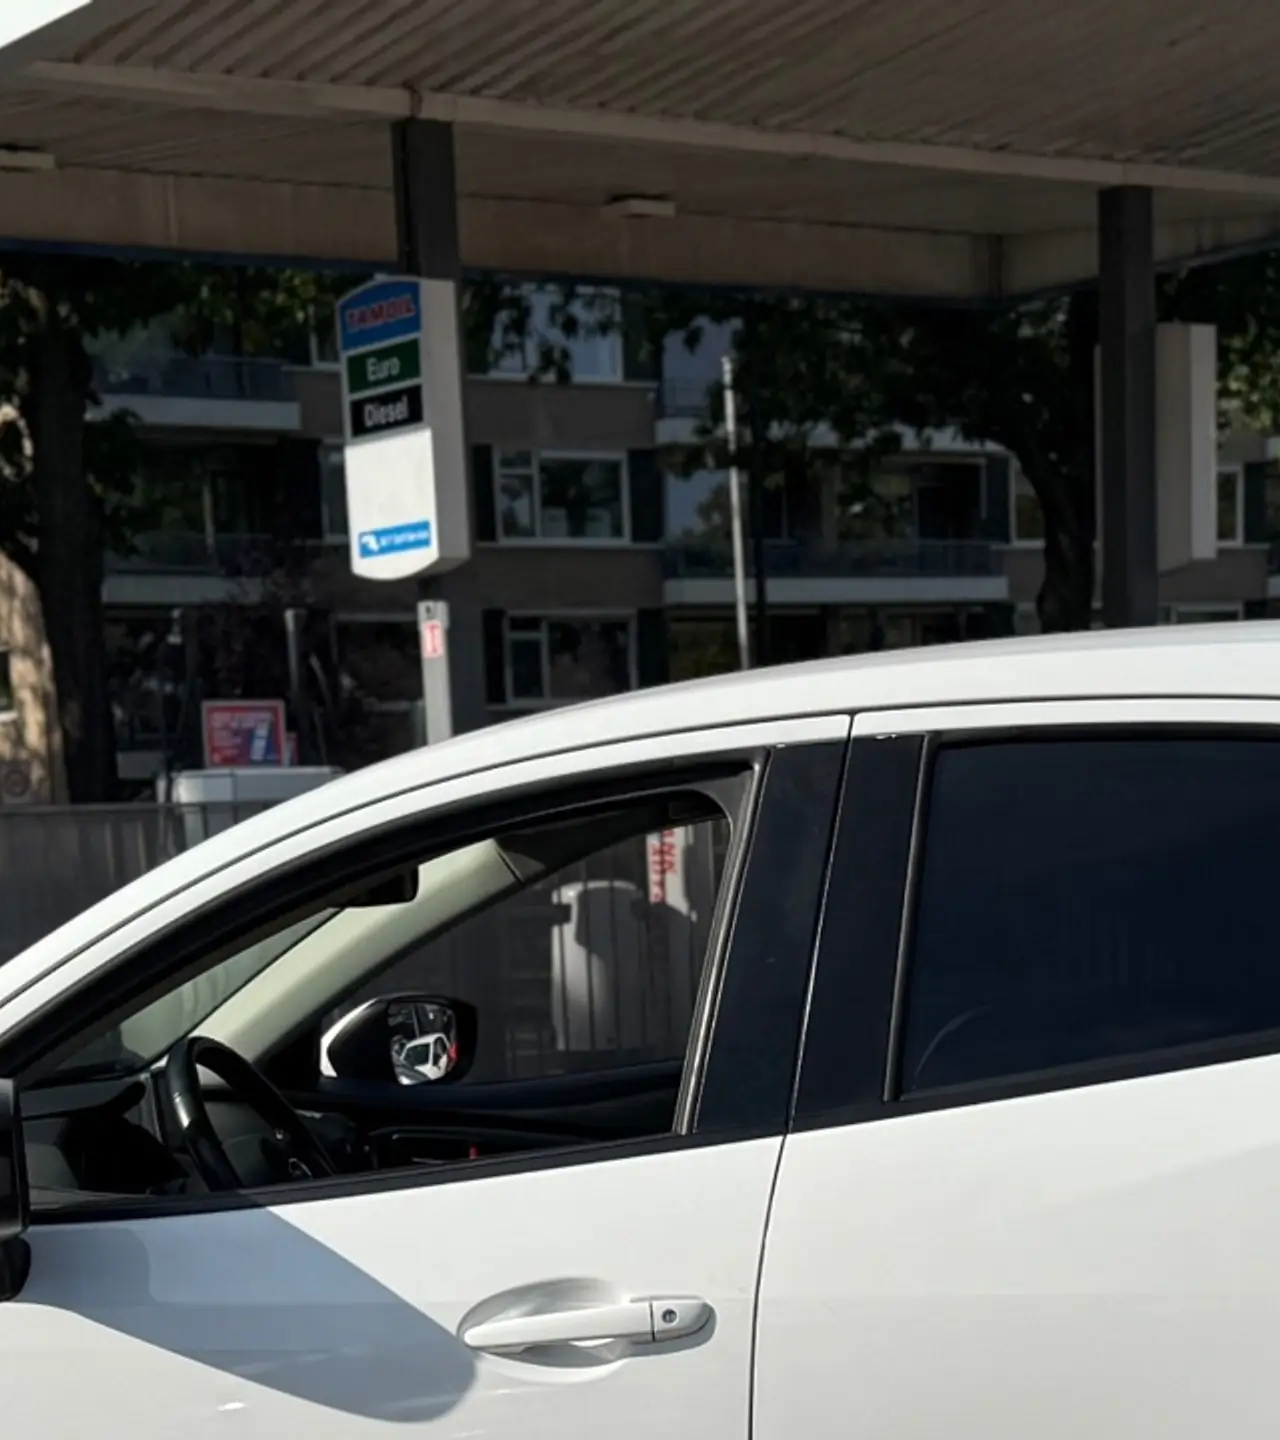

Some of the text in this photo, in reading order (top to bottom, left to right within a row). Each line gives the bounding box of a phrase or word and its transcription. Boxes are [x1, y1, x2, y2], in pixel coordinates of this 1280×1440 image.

[346, 294, 416, 332] TAMOIL
[365, 355, 401, 383] Euro
[363, 394, 410, 429] Diesel
